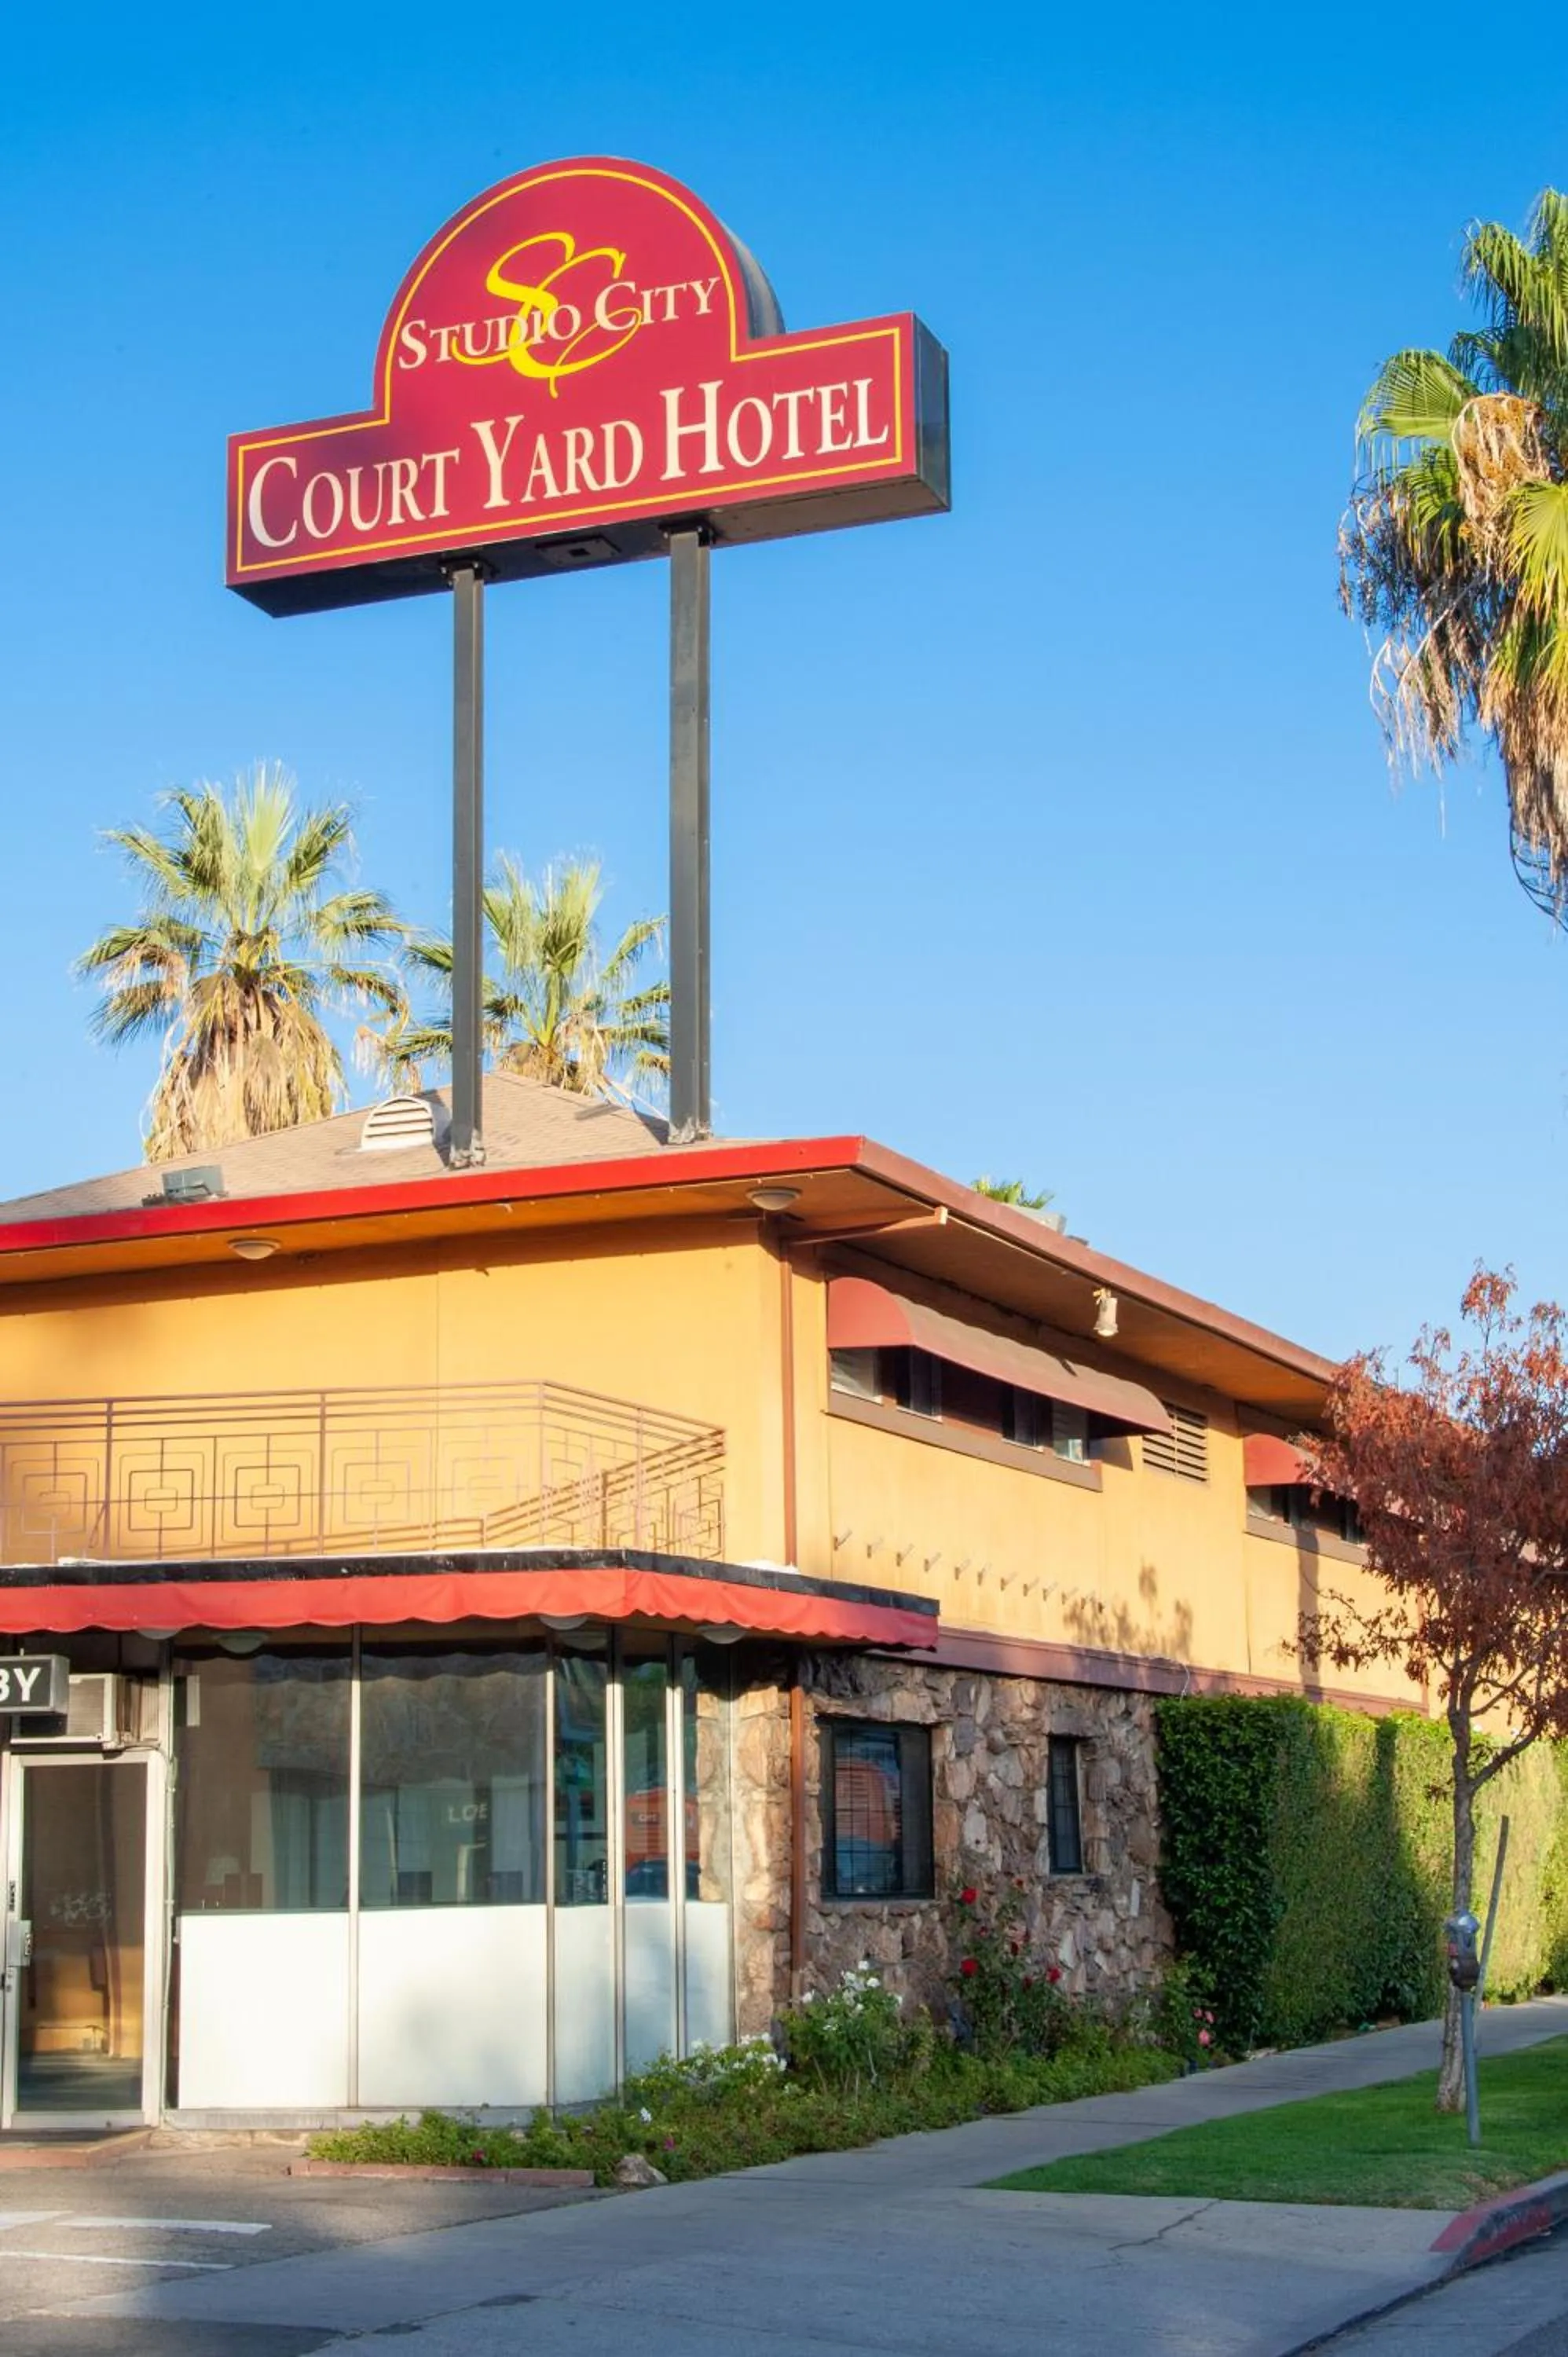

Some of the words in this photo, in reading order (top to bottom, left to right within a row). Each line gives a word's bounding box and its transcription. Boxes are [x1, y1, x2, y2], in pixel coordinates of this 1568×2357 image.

[398, 306, 581, 369] STUDIO
[595, 277, 720, 332] CITY
[247, 449, 460, 548] COURT
[471, 414, 643, 509] YARD
[659, 378, 890, 481] HOTEL
